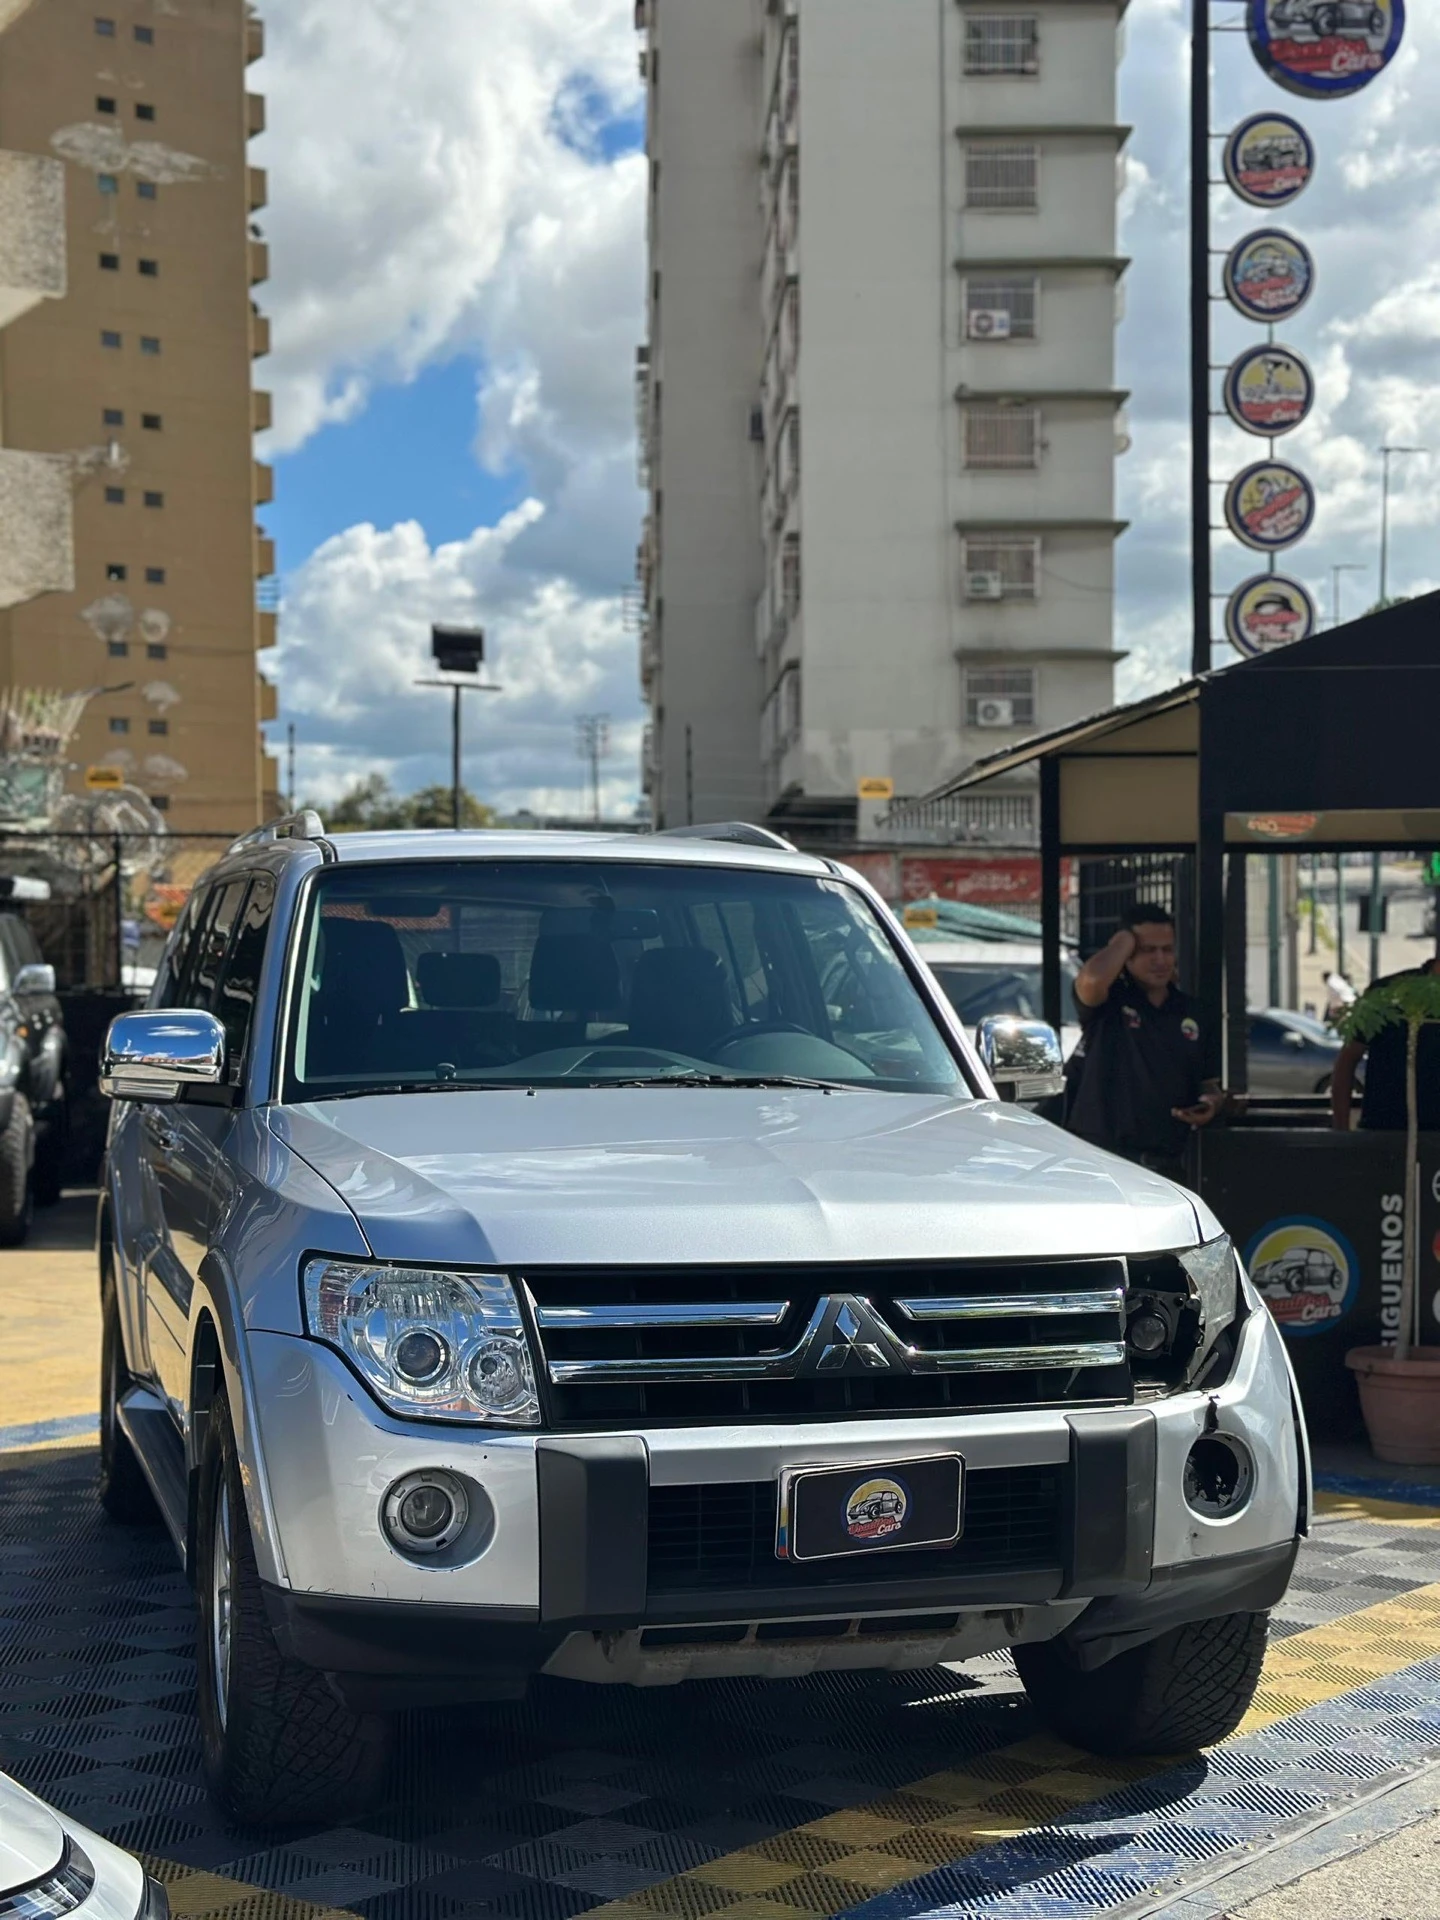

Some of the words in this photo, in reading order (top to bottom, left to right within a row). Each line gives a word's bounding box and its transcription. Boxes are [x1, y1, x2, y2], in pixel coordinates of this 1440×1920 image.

[1331, 51, 1382, 72] Cars
[1301, 1303, 1342, 1321] Cars
[877, 1522, 901, 1534] Cars
